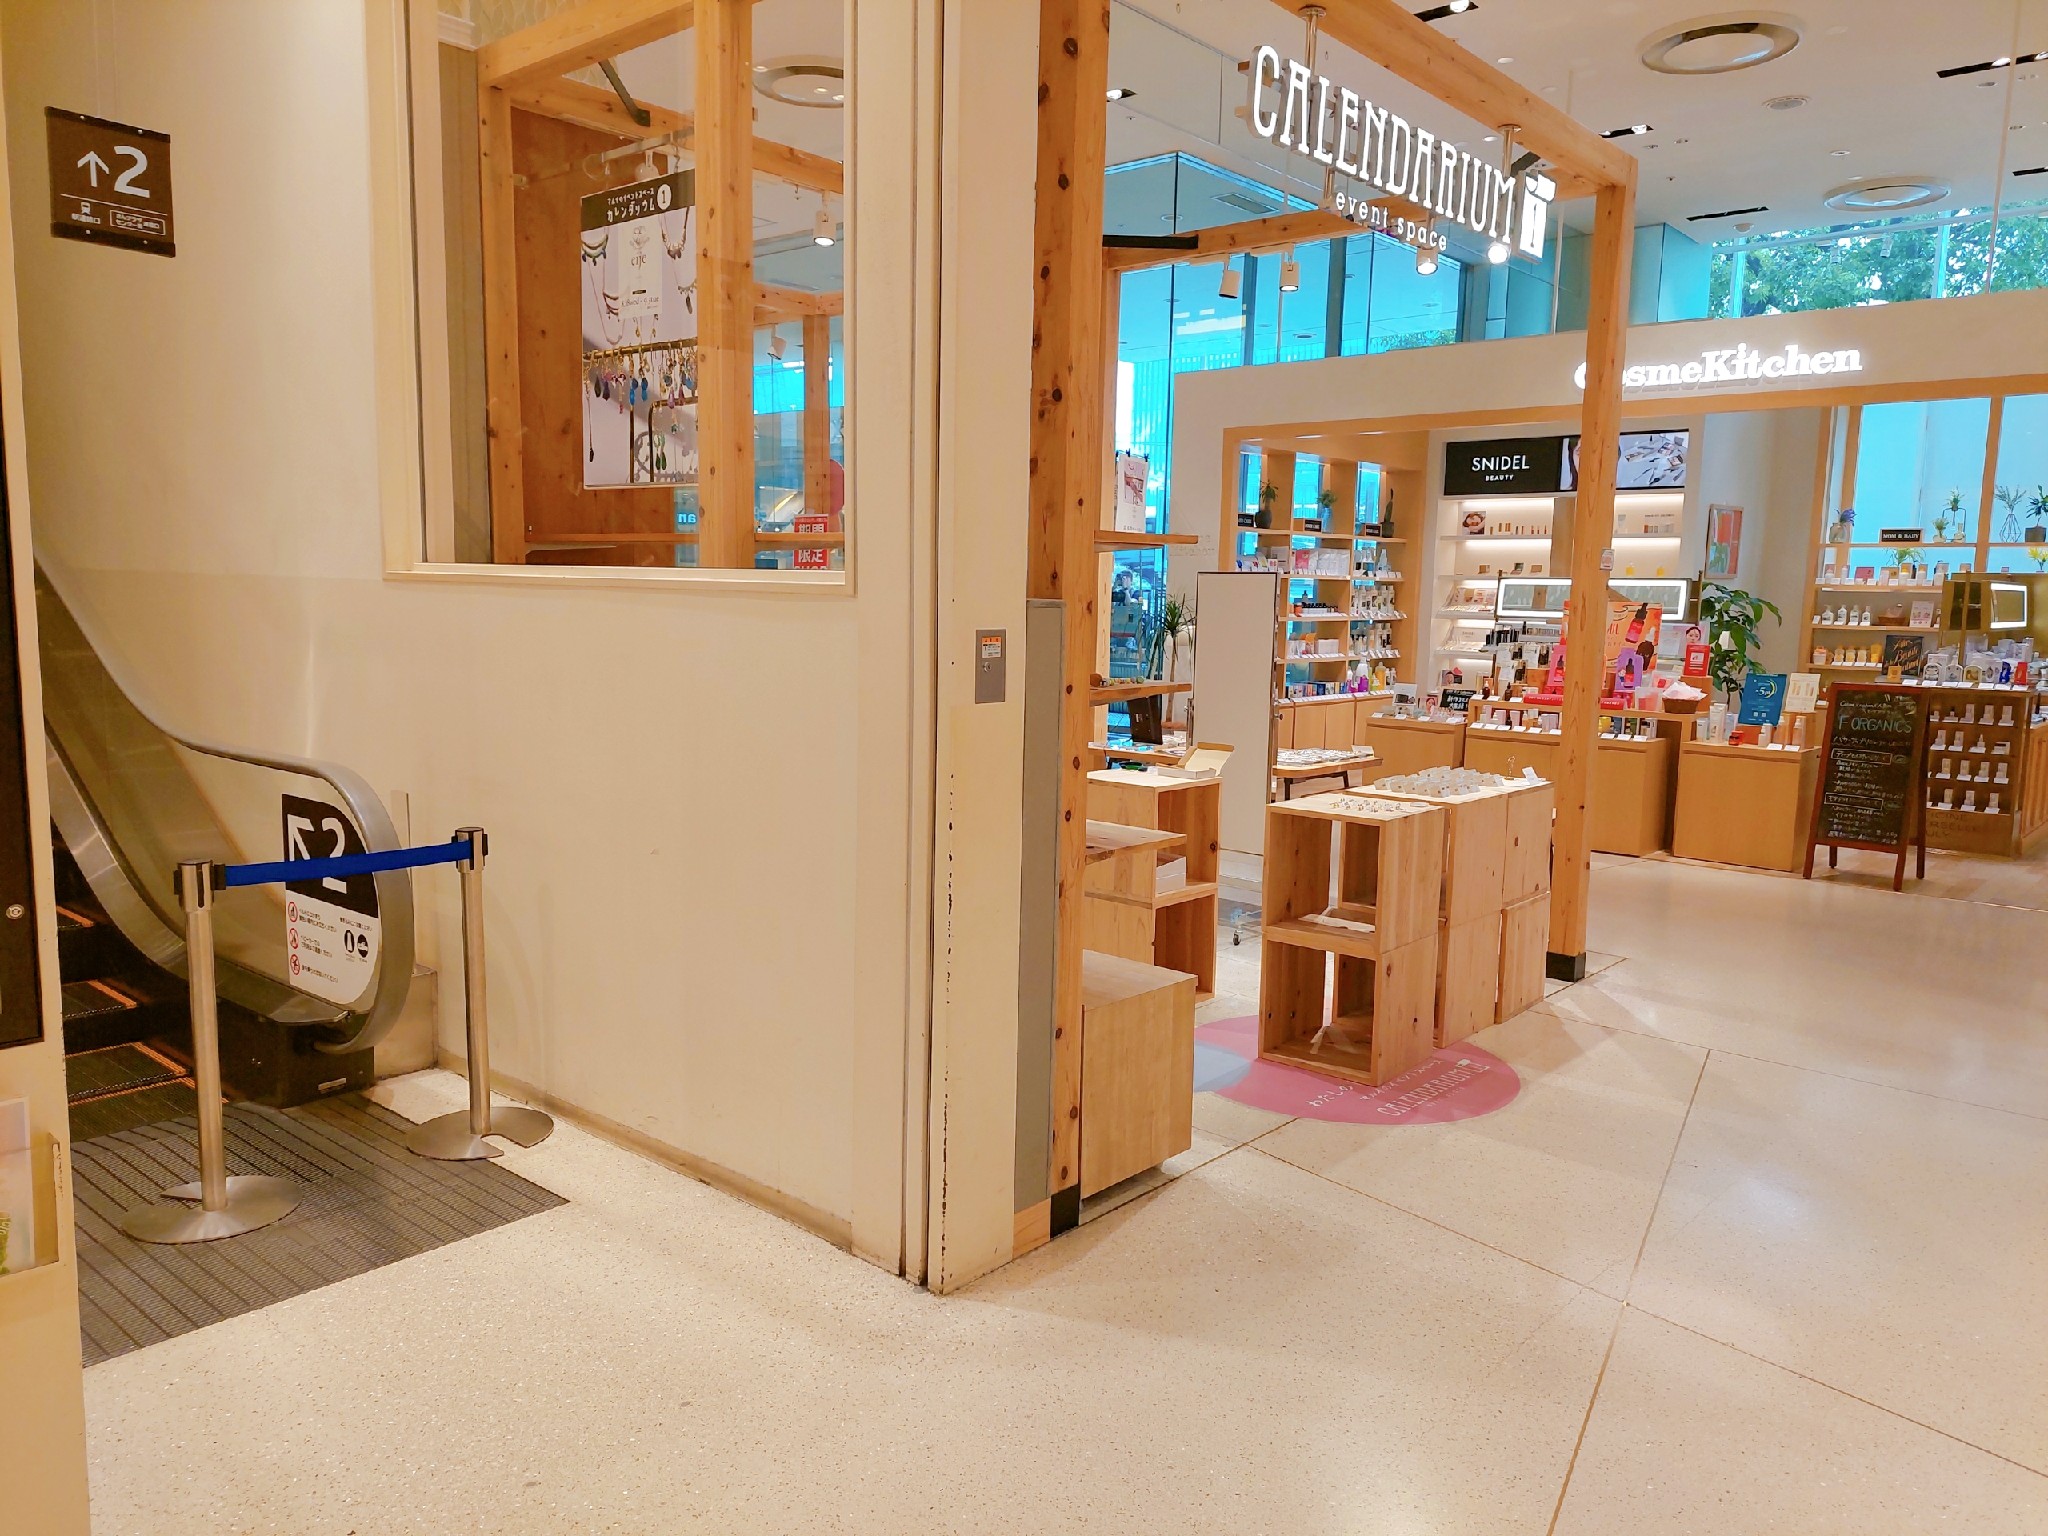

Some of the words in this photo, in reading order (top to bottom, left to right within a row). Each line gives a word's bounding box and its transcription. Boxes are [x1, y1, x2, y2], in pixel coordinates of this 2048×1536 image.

[1253, 45, 1517, 243] CALENDARIUM
[113, 145, 150, 198] 2
[1335, 191, 1389, 229] event
[1397, 217, 1447, 251] space
[1574, 343, 1863, 390] CsmeKitchen
[1471, 454, 1531, 472] SNIDEL
[1485, 474, 1514, 482] BEAUTY
[321, 817, 348, 895] 2
